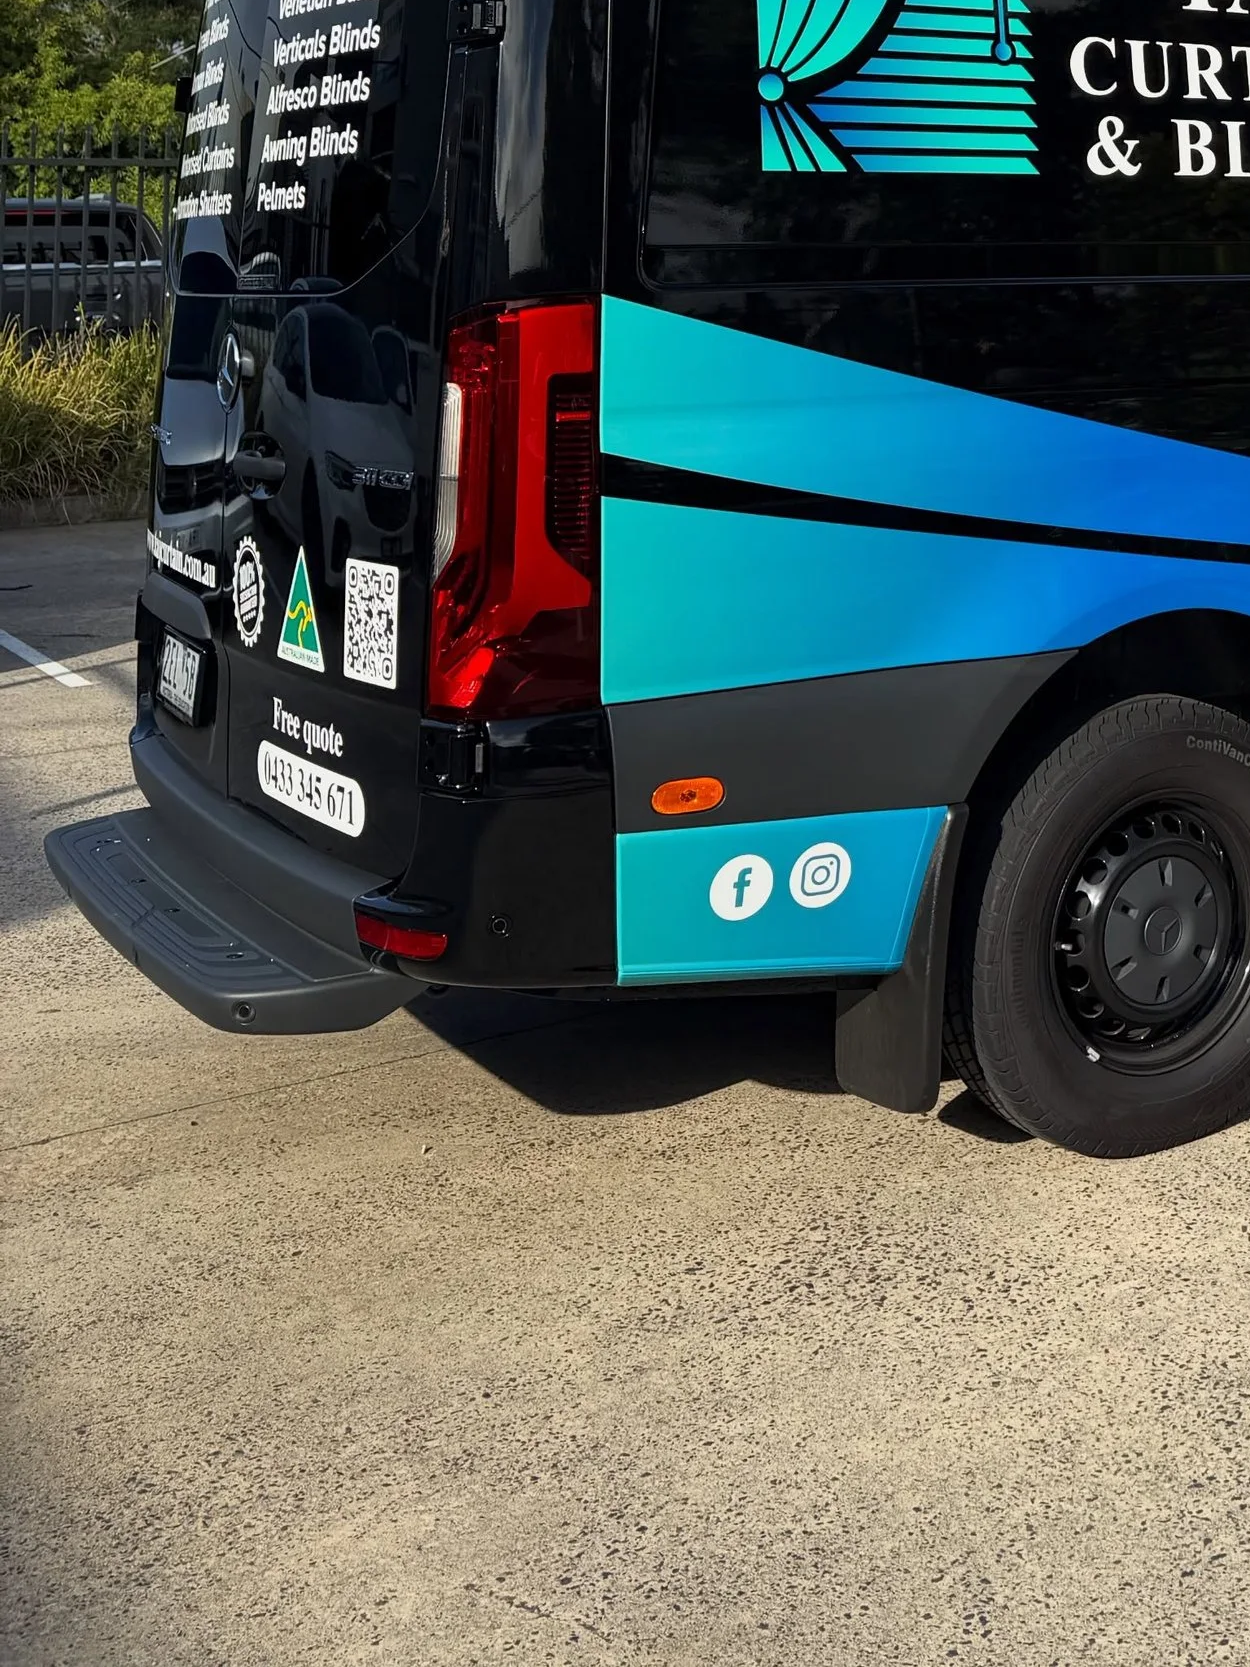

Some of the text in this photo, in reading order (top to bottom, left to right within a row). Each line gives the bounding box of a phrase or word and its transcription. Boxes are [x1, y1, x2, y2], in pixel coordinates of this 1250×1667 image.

[209, 13, 230, 46] Blinds
[273, 19, 381, 67] Verticals Blinds
[204, 57, 225, 89] Blinds
[266, 71, 371, 115] Alfresco Blinds
[207, 97, 231, 129] Blinds
[202, 142, 235, 173] Curtains
[261, 123, 359, 167] Awning Blinds
[1086, 115, 1142, 176] &
[199, 189, 233, 216] Shutters
[257, 181, 306, 212] Pelmets
[273, 696, 344, 757] Free quote
[264, 751, 354, 826] 0433 345 671
